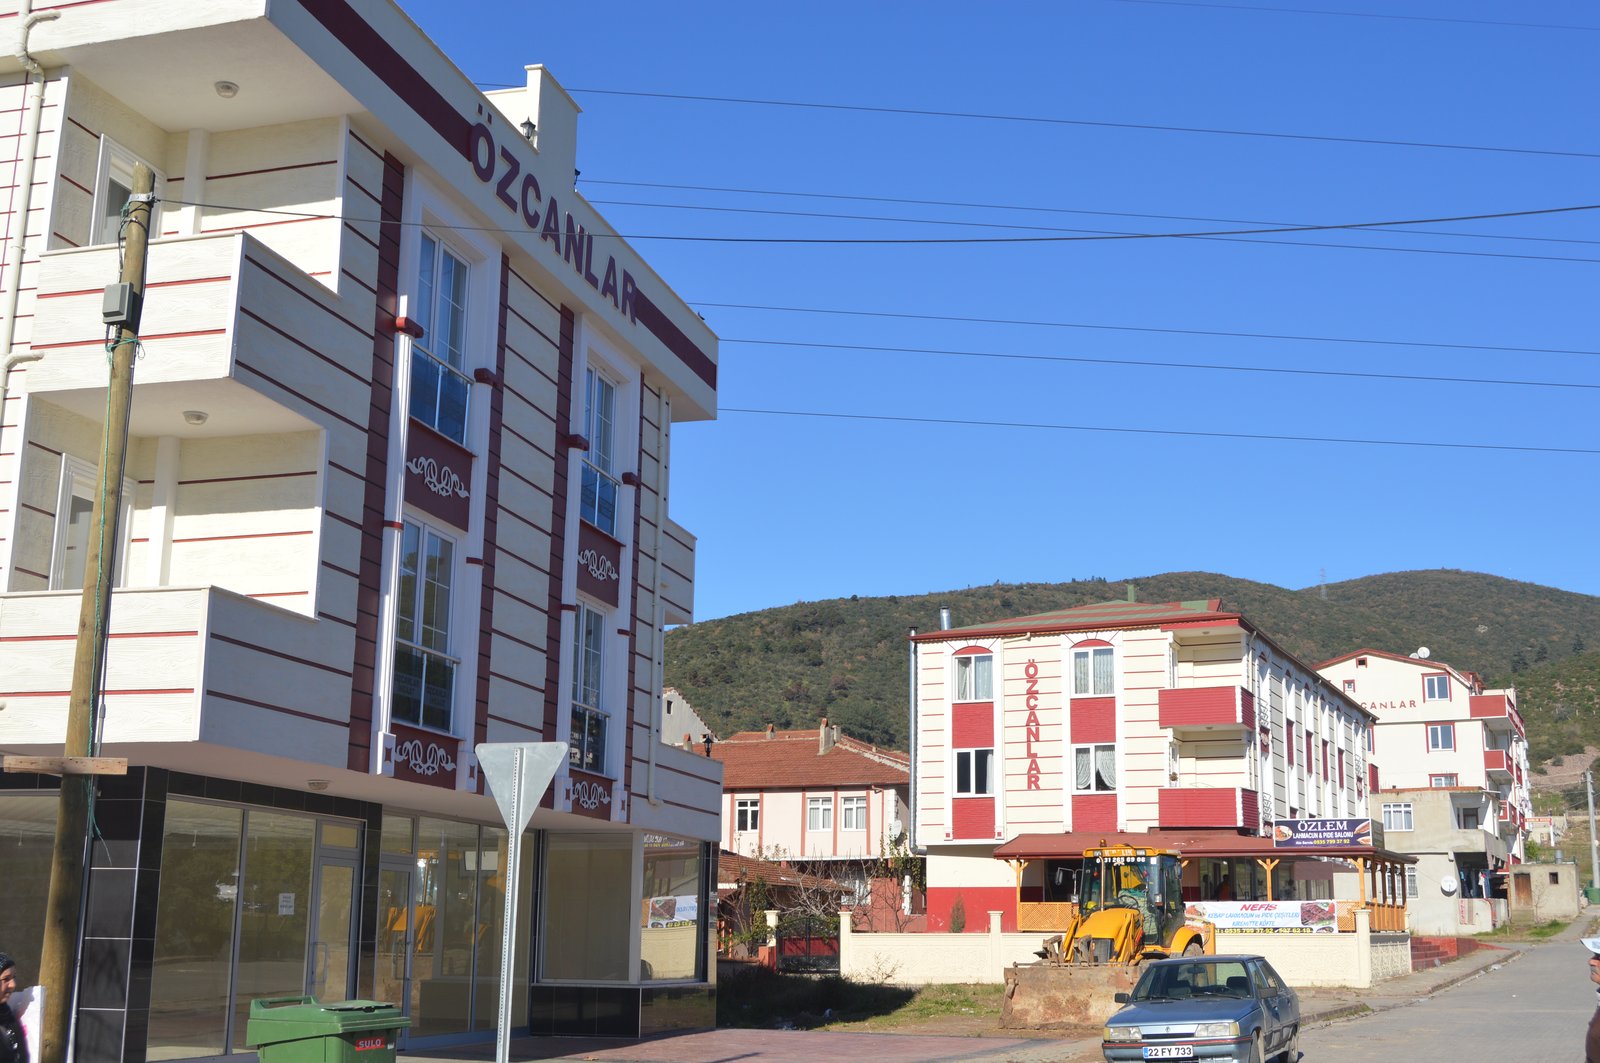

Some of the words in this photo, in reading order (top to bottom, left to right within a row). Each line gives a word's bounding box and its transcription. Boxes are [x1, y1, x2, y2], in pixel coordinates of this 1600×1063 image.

[470, 102, 637, 326] ÖZCANLAR
[1024, 659, 1041, 790] ÖZCANLAR
[1297, 820, 1348, 832] ÖZLEM
[359, 1039, 381, 1048] SULO
[1148, 1048, 1159, 1056] 22
[1161, 1047, 1172, 1056] FY
[1175, 1047, 1192, 1056] 733
